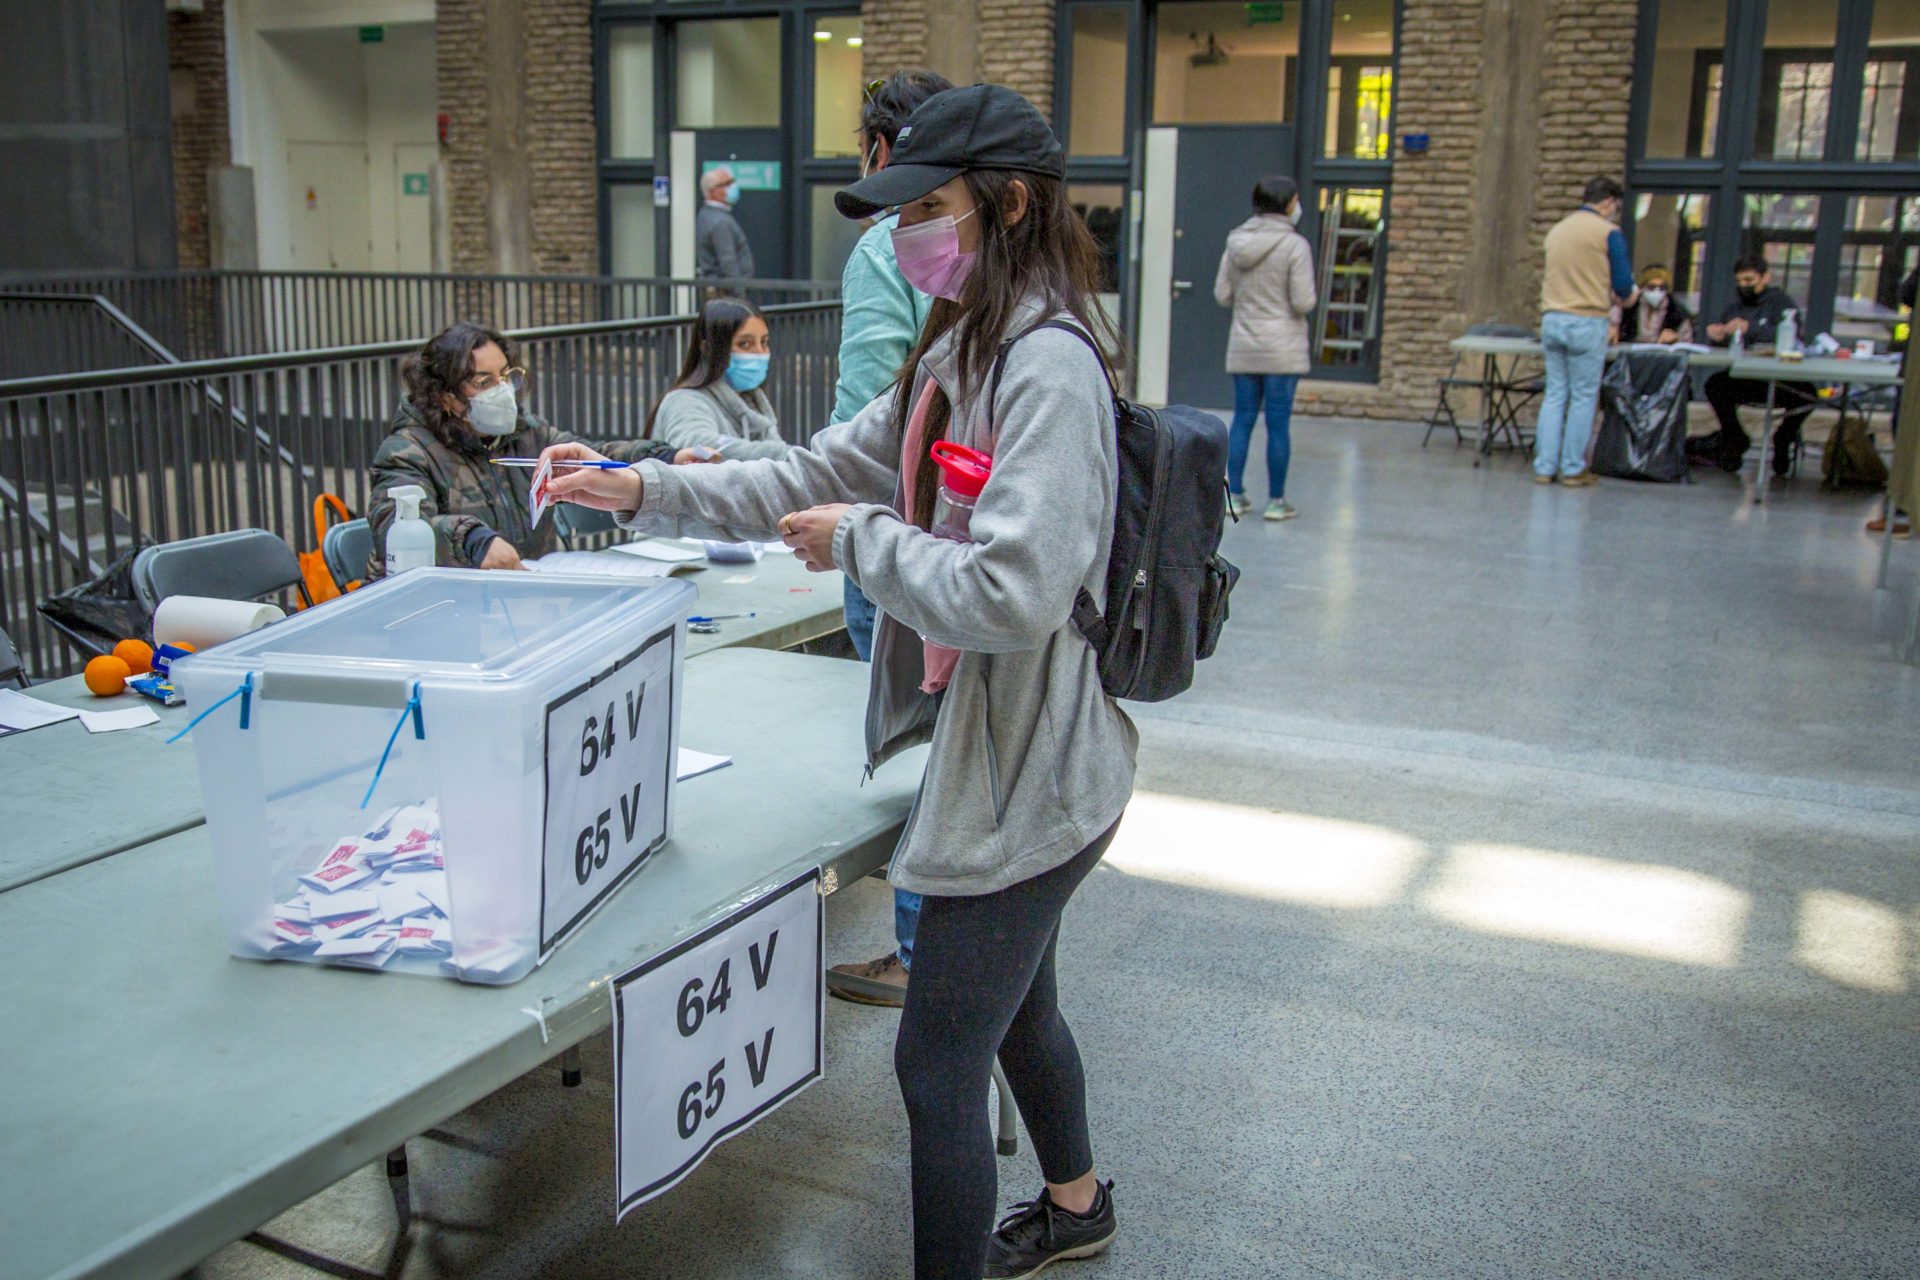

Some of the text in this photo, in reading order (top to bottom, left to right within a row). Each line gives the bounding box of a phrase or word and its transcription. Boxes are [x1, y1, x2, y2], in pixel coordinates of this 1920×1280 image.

[580, 681, 646, 777] 64 V
[575, 782, 641, 886] 65 V
[676, 929, 779, 1038] 64 V
[677, 1026, 775, 1140] 65 V
